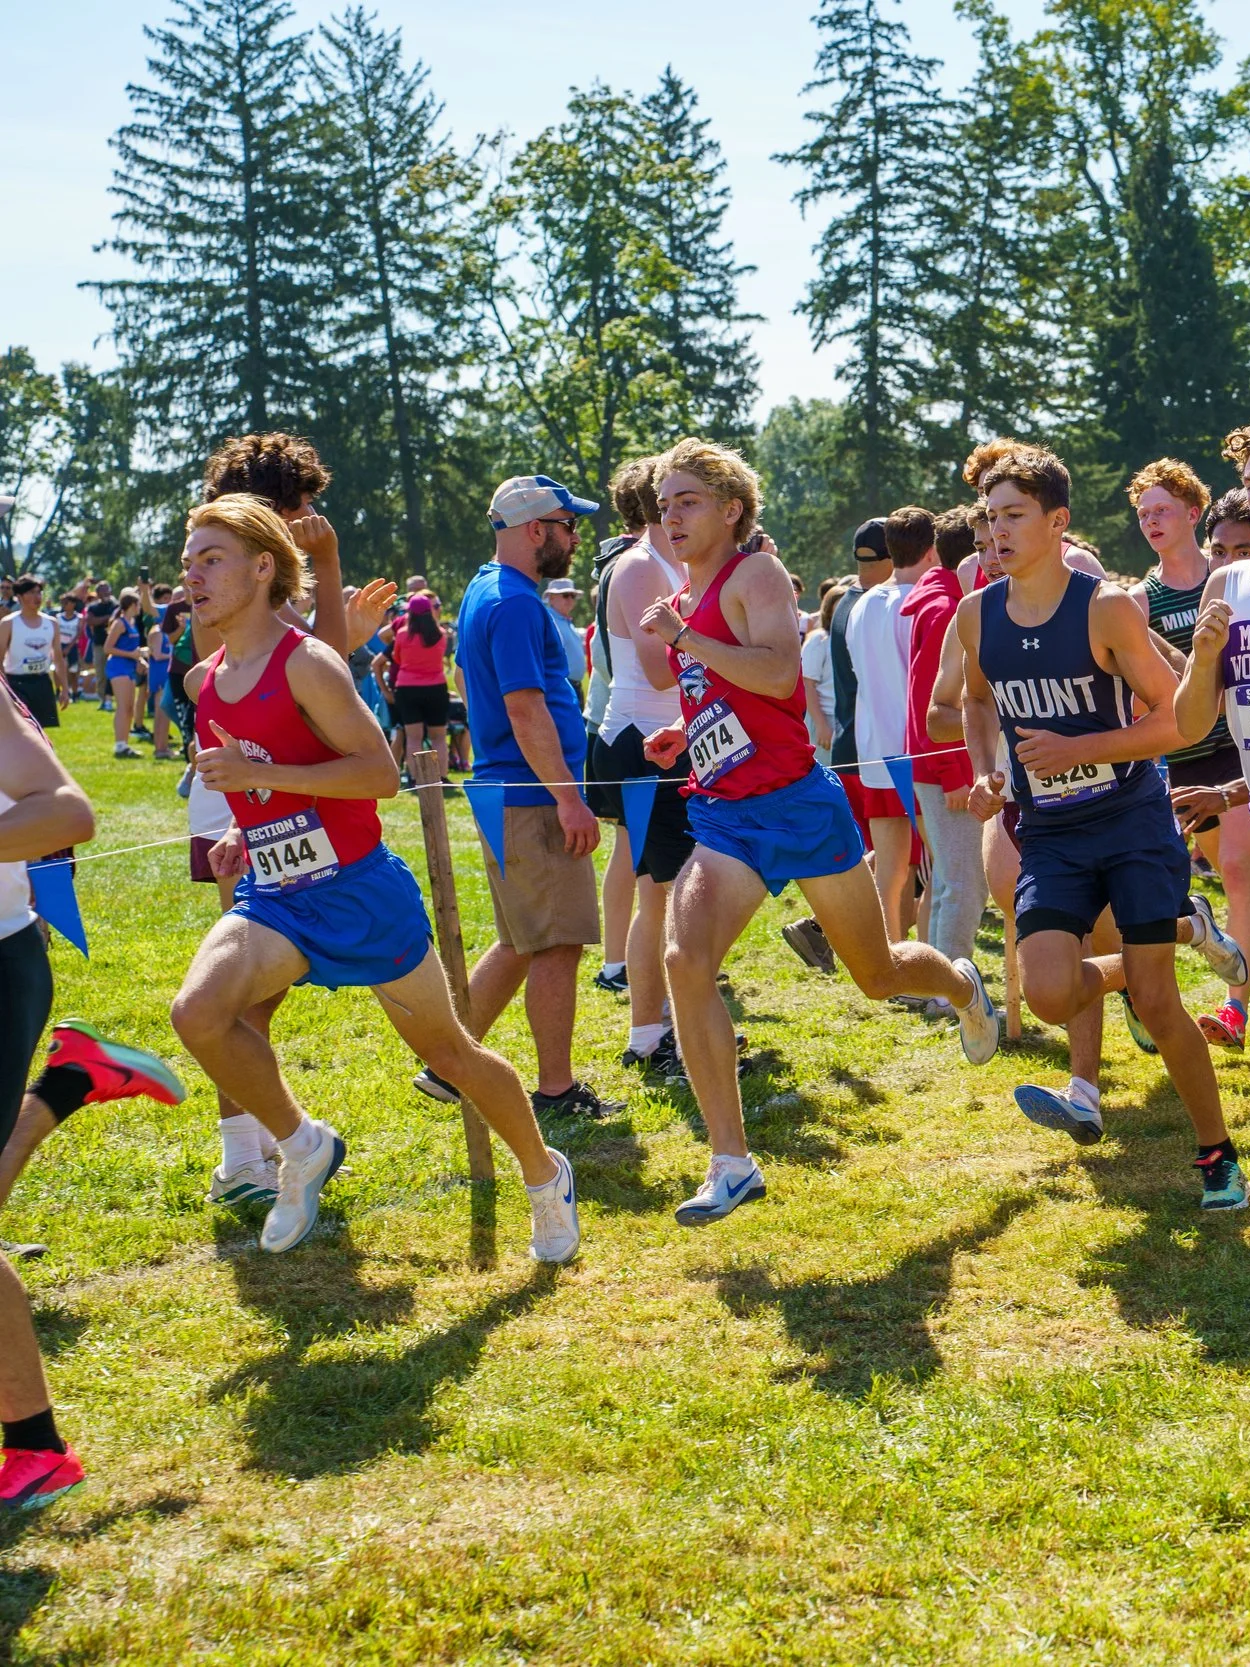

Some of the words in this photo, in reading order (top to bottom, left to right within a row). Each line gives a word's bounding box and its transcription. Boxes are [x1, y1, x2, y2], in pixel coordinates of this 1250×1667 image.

[988, 675, 1096, 718] MOUNT
[687, 707, 715, 739] SECTION
[712, 703, 722, 714] 9
[693, 722, 734, 768] 9174
[247, 817, 294, 843] SECTION
[297, 815, 308, 828] 9
[257, 838, 317, 876] 9144
